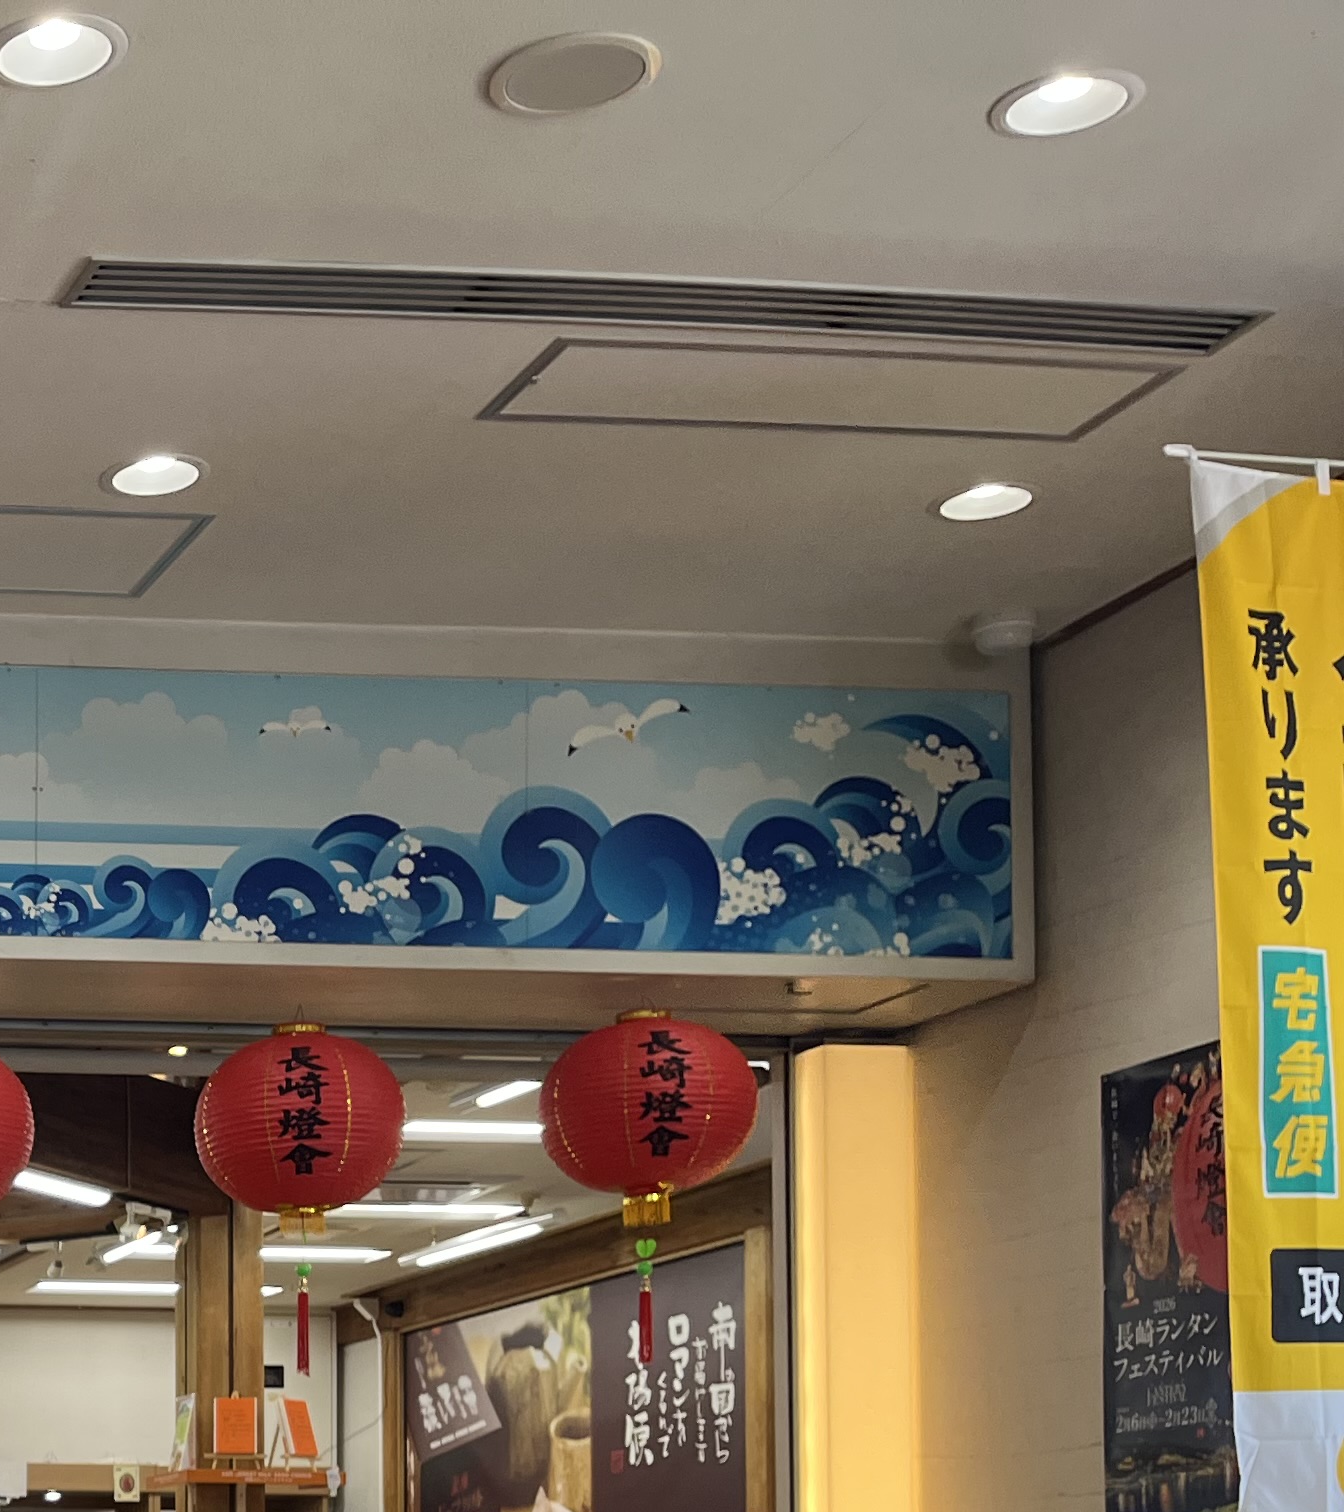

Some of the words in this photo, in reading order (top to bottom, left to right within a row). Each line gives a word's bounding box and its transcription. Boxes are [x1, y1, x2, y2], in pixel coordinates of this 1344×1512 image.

[1248, 608, 1312, 924] 承ります
[1271, 967, 1329, 1181] 宅急便
[1114, 1345, 1224, 1382] フェスティバル
[1115, 1313, 1218, 1353] 長崎ランタン
